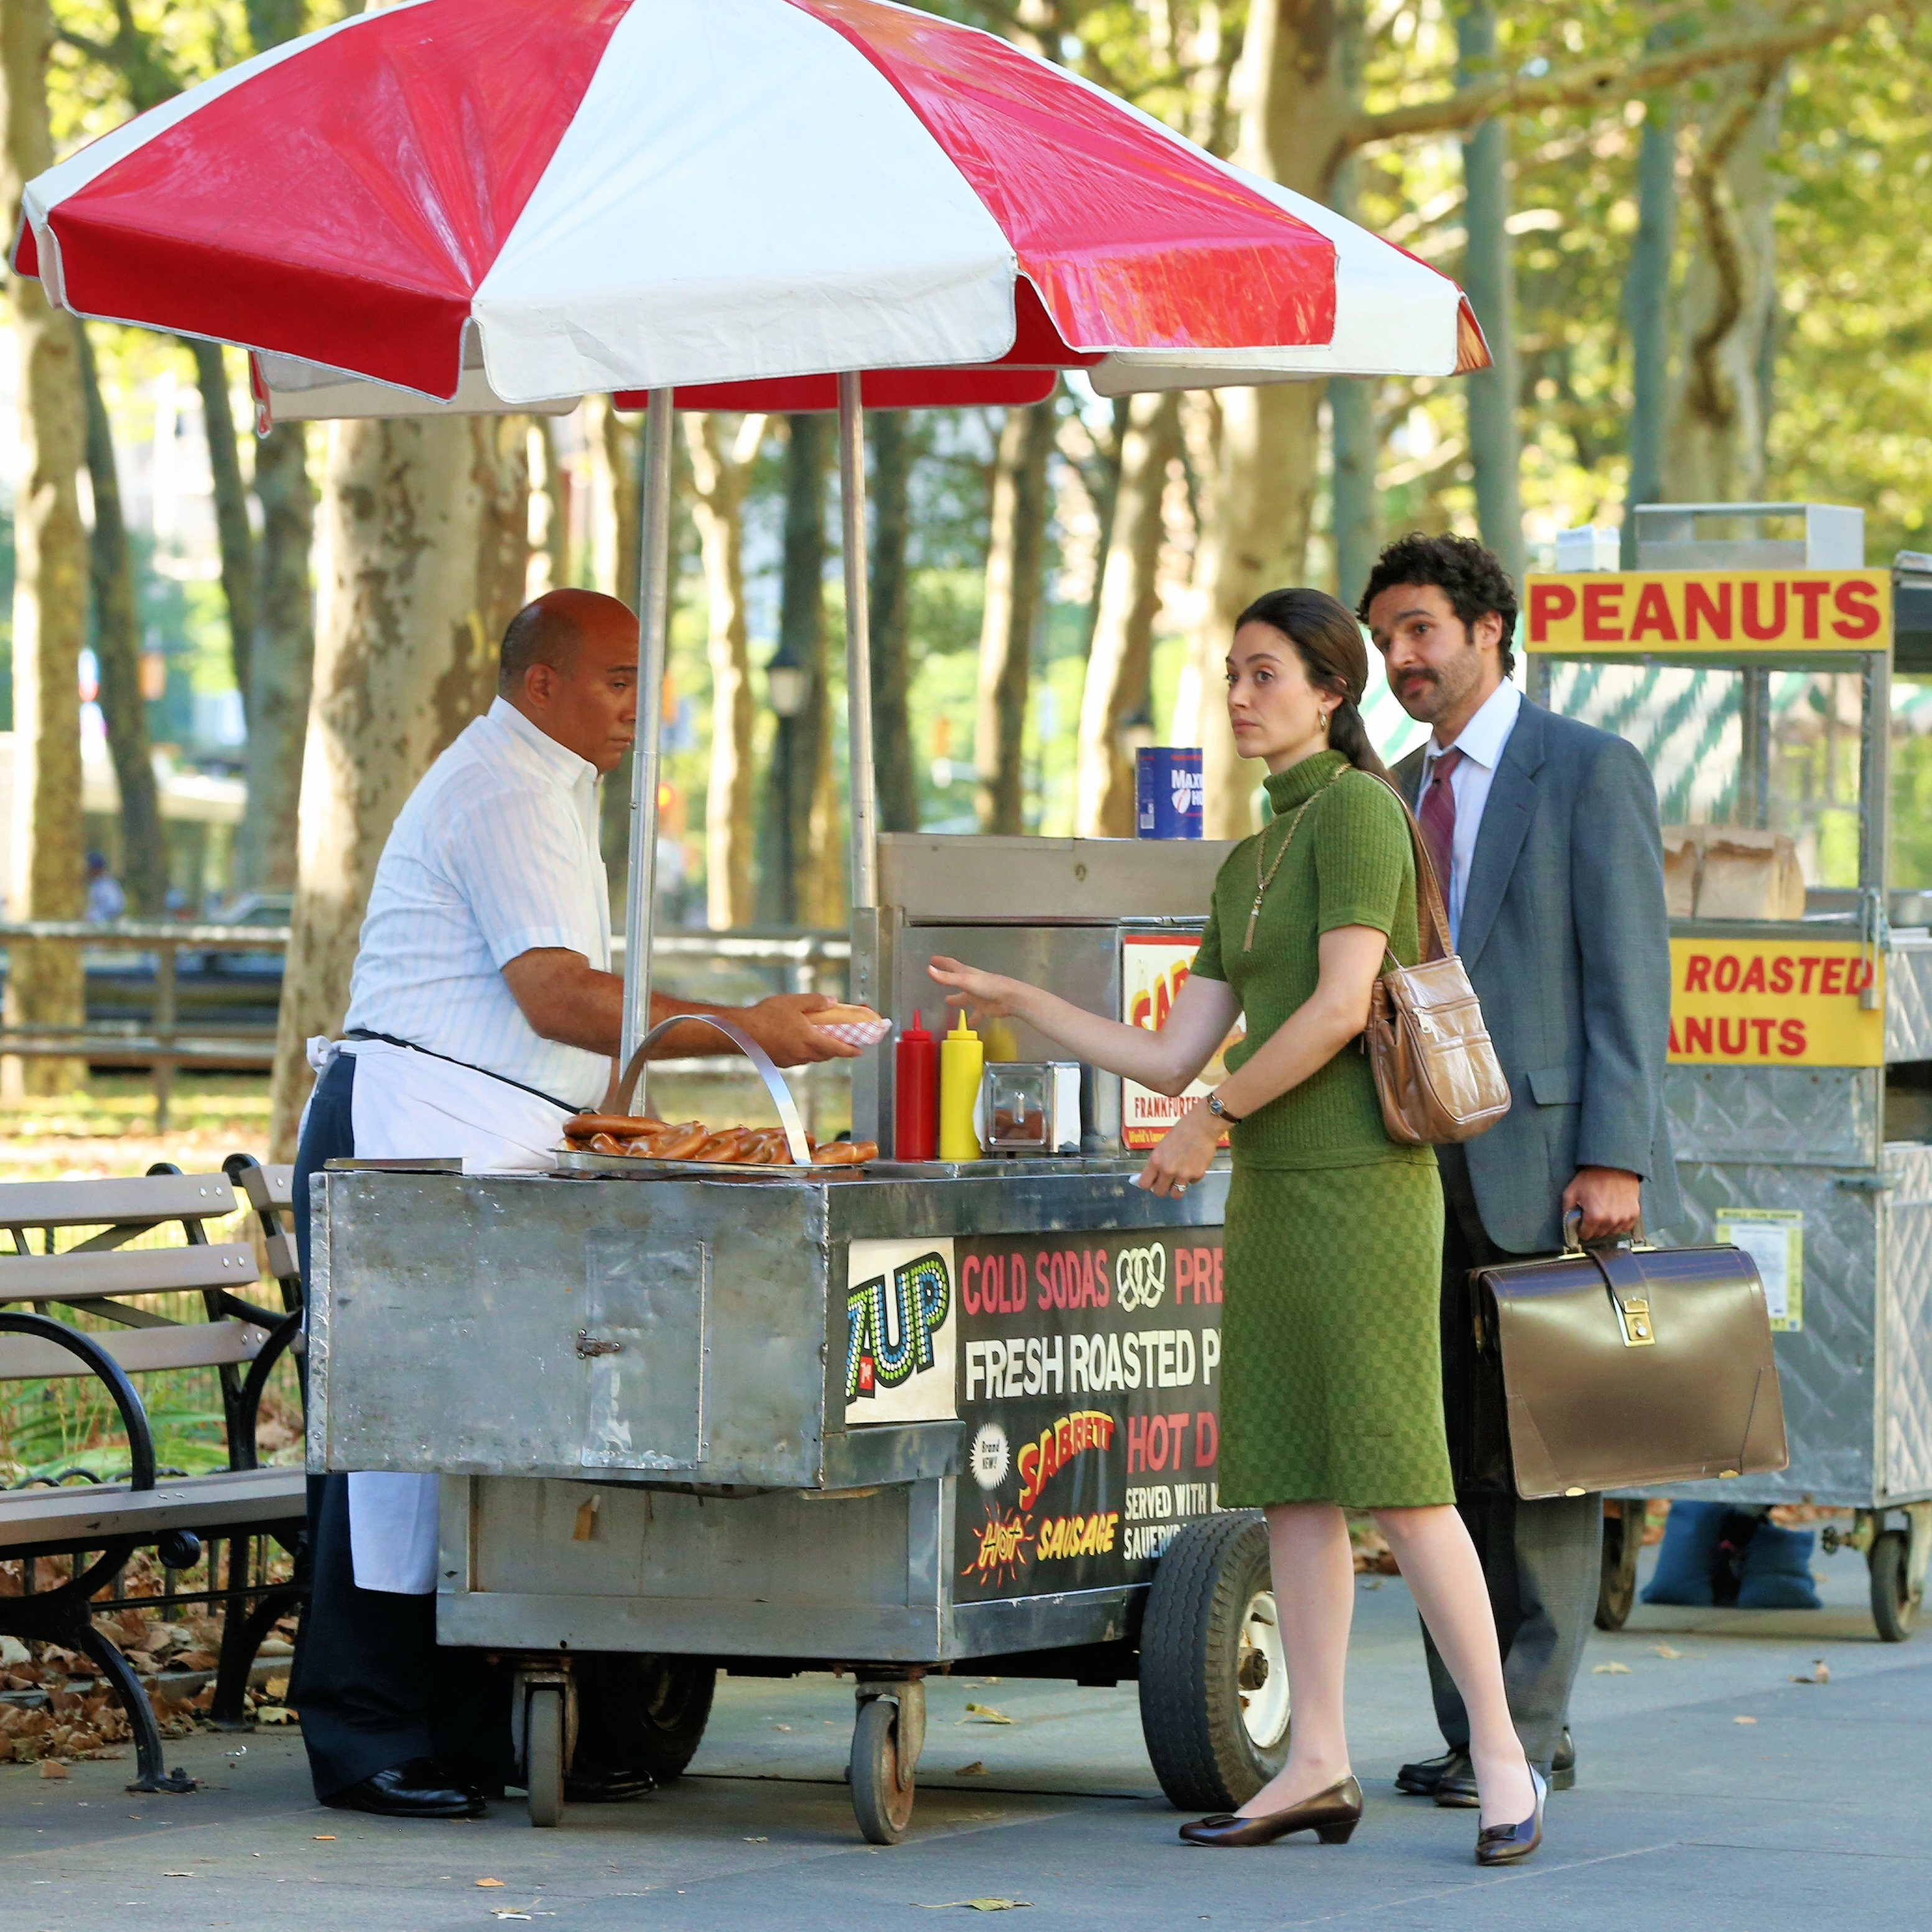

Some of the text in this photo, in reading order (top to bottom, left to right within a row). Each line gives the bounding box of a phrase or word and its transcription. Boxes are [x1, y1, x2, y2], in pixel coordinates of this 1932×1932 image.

[1530, 580, 1881, 643] PEANUTS
[1685, 955, 1874, 996] ROASTED
[962, 1253, 1028, 1316] COLD
[1035, 1248, 1111, 1311] SODAS
[847, 1259, 948, 1398] 7UP
[965, 1335, 1064, 1401] FRESH
[1069, 1328, 1196, 1393] ROASTED
[982, 1439, 1000, 1453] Brand
[1017, 1409, 1115, 1511] SABRETT
[1127, 1412, 1191, 1474] HOT
[1124, 1484, 1173, 1521] SERVED
[1173, 1482, 1207, 1516] WITH
[1036, 1512, 1119, 1561] SAUSAGE
